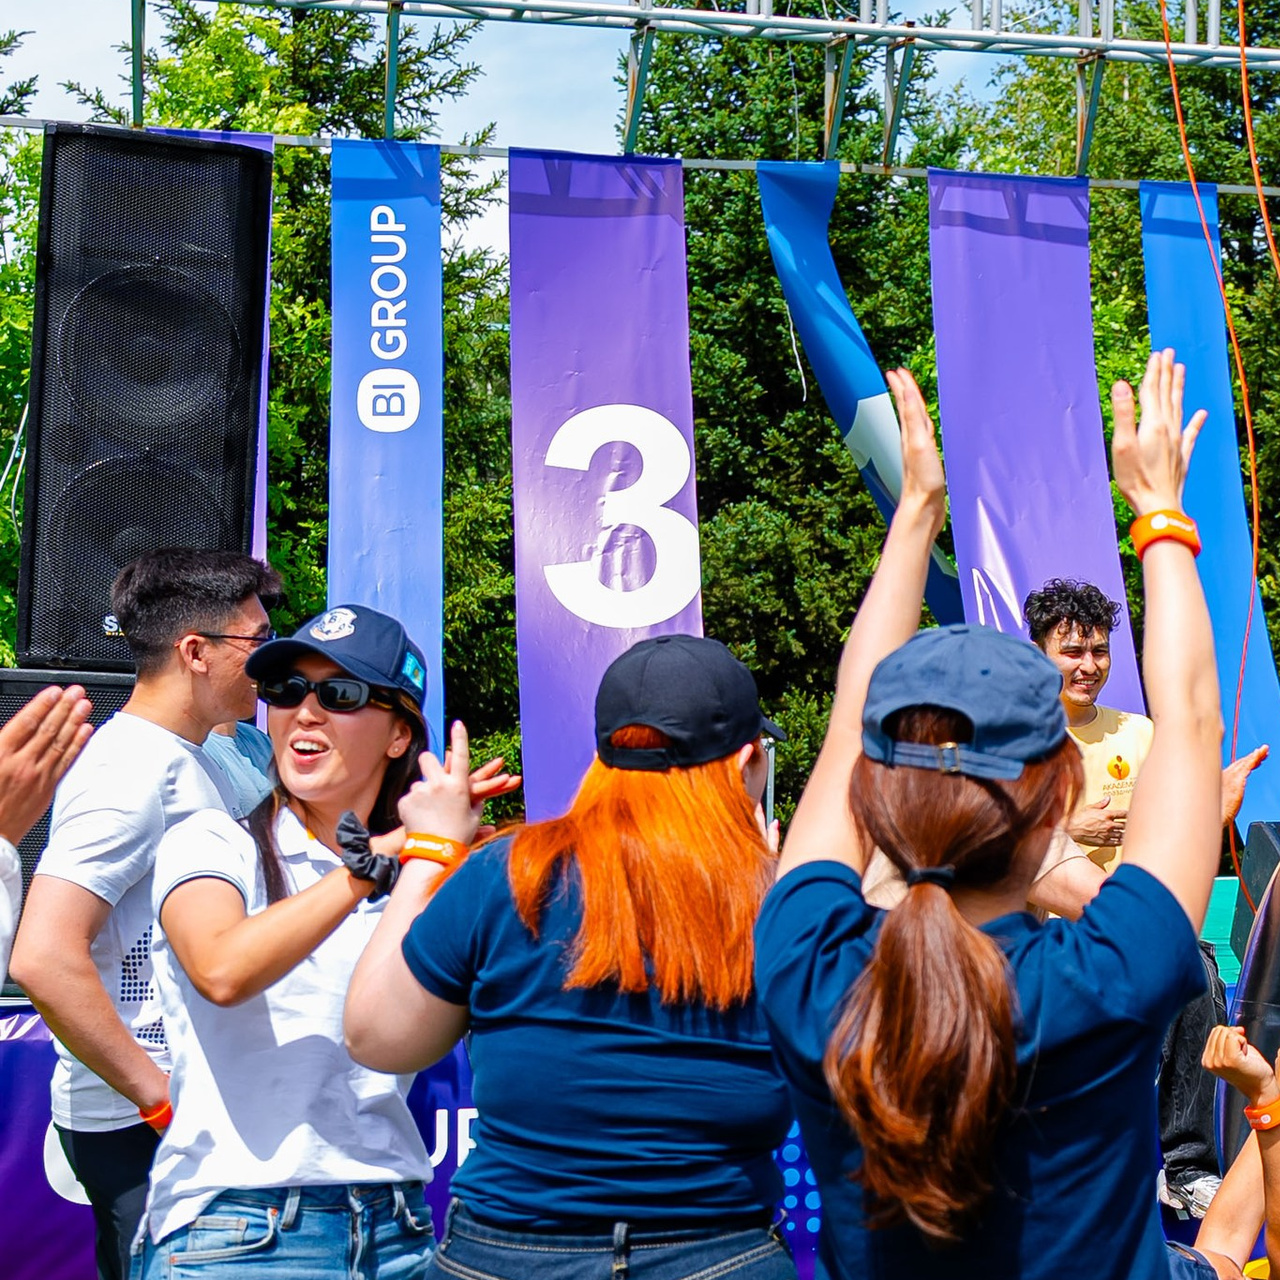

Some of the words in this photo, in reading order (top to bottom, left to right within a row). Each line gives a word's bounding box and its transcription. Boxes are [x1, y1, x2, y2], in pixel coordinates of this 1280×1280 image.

[370, 204, 408, 360] GROUP
[372, 384, 406, 417] BI
[543, 403, 702, 629] 3
